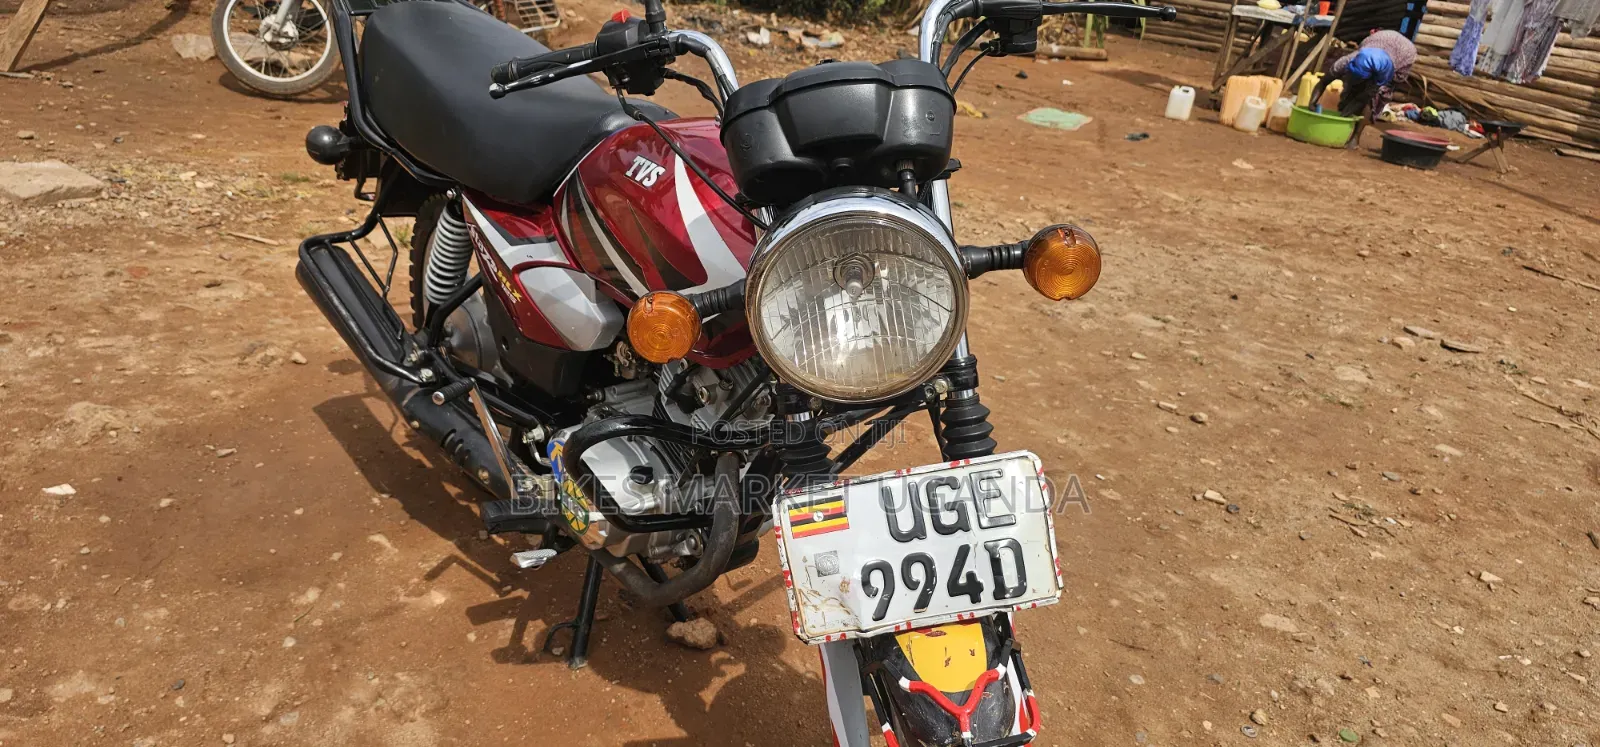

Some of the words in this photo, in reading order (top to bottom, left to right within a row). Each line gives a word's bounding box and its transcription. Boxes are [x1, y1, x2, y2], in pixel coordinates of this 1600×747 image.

[626, 155, 665, 188] TVS
[881, 468, 1017, 543] UGE
[860, 537, 1028, 621] 994D
